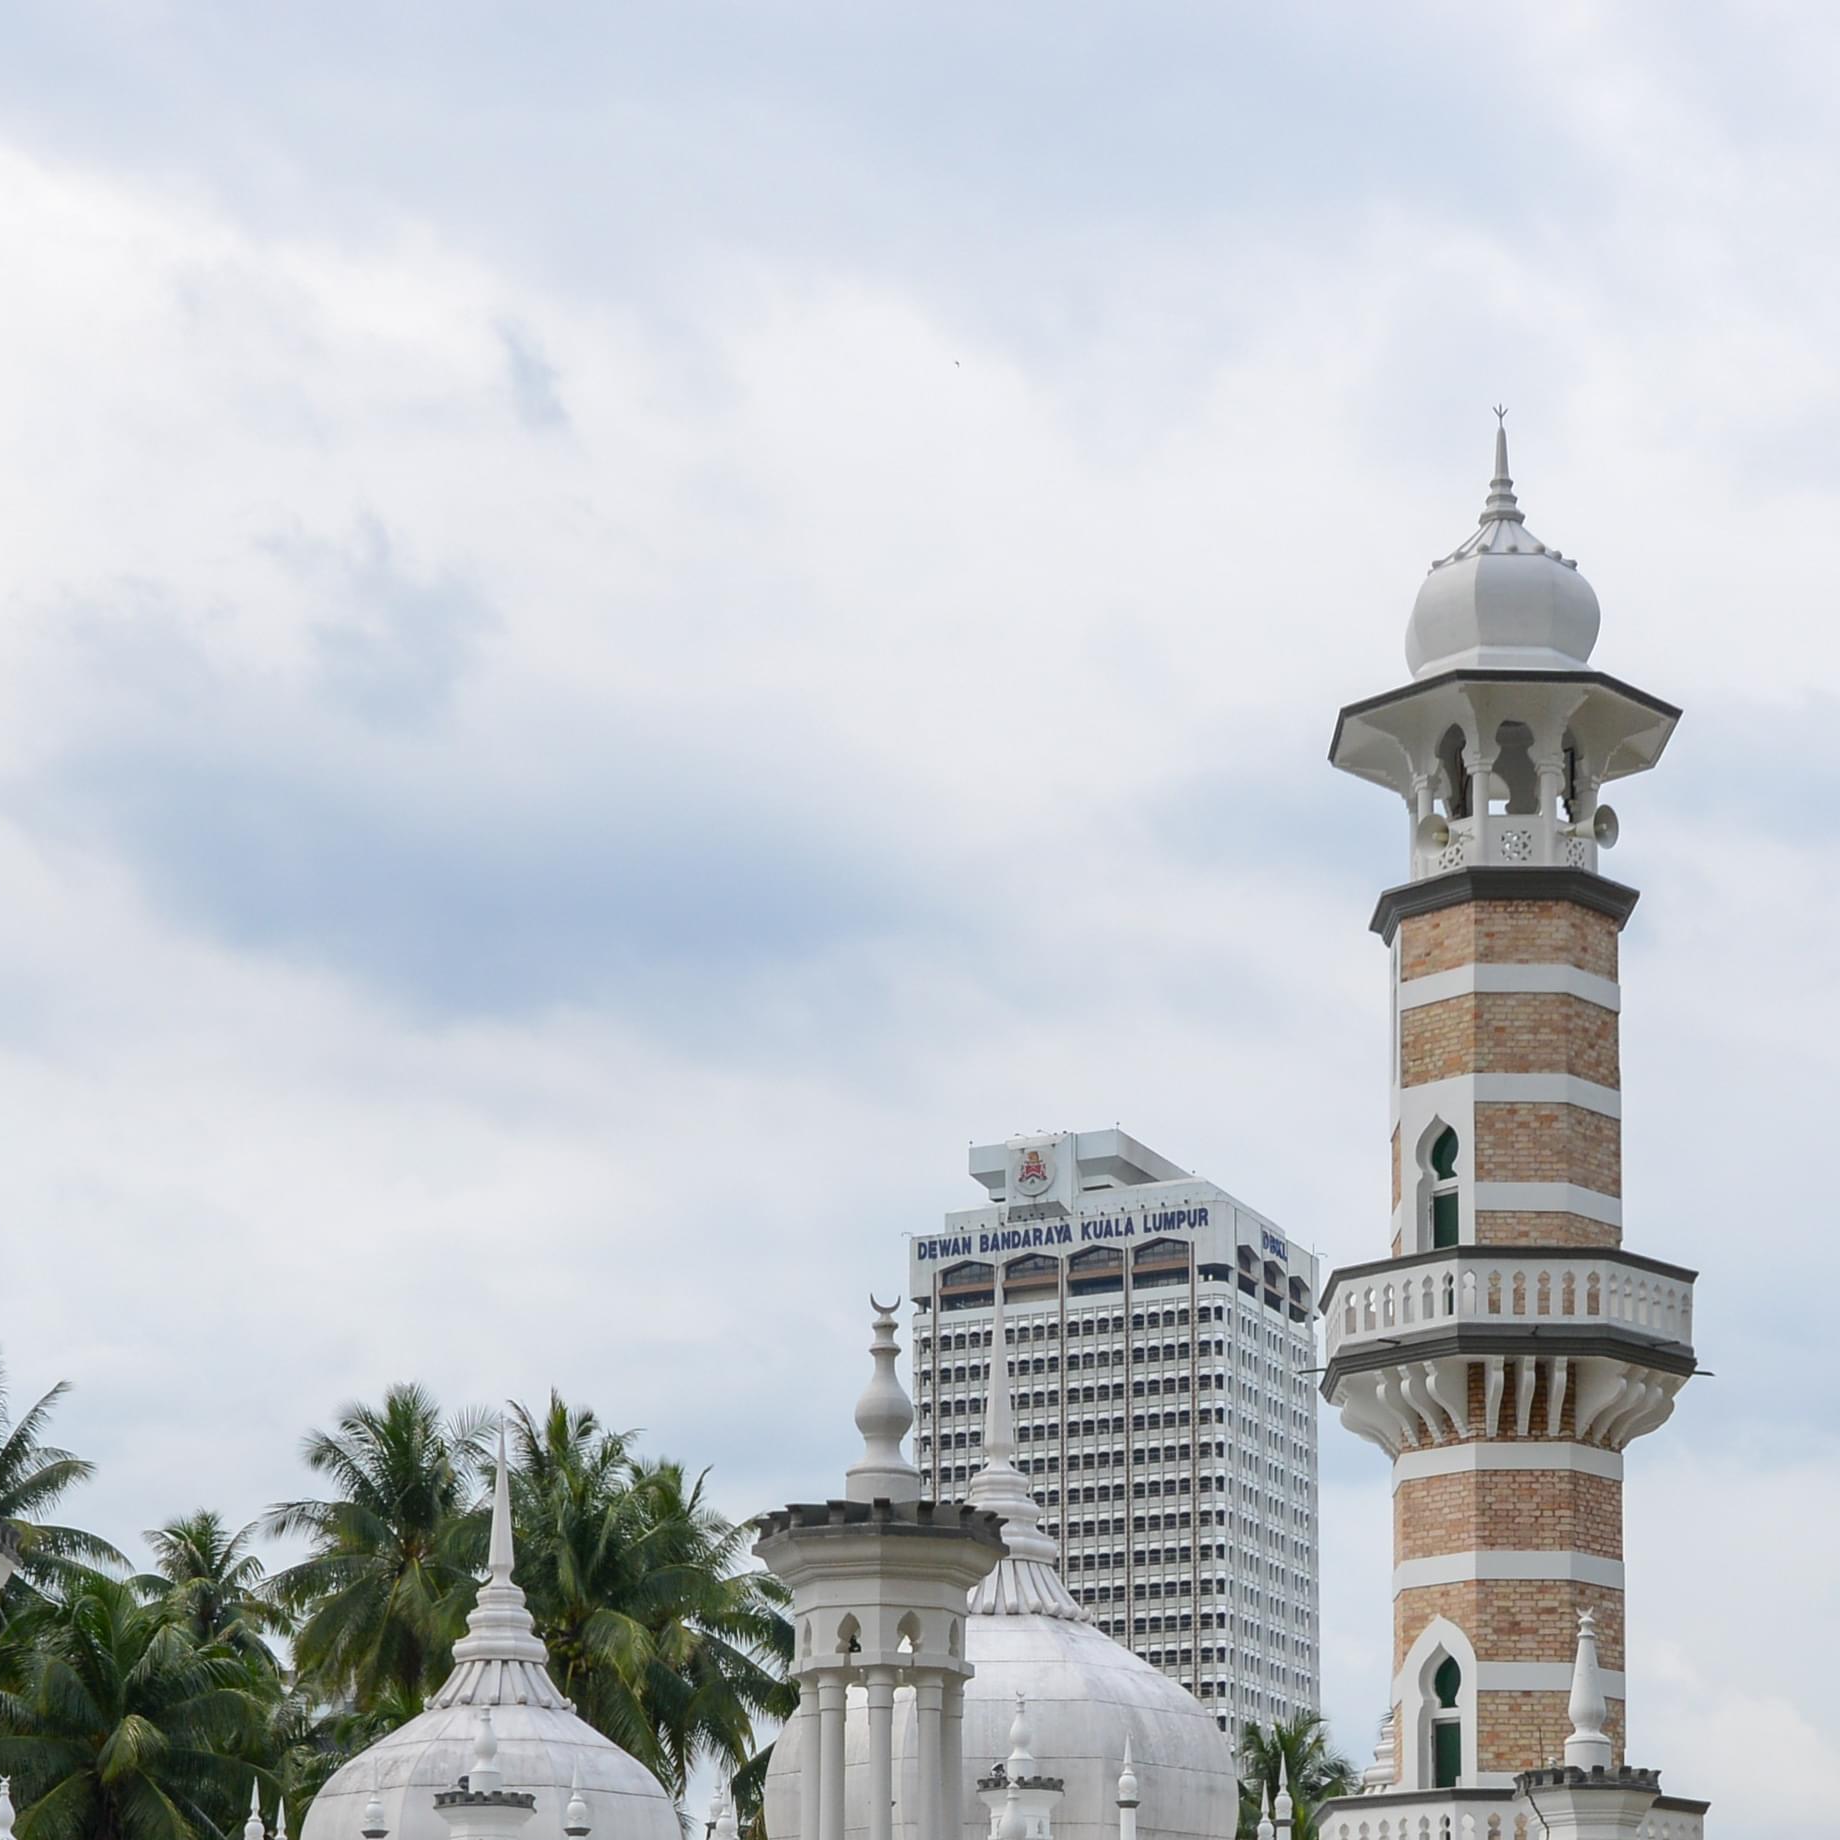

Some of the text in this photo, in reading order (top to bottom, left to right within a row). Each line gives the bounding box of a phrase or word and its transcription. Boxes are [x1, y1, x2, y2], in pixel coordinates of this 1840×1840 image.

[917, 1207, 1209, 1260] DEWAN BANDARAYA KUALA LUMPUR
